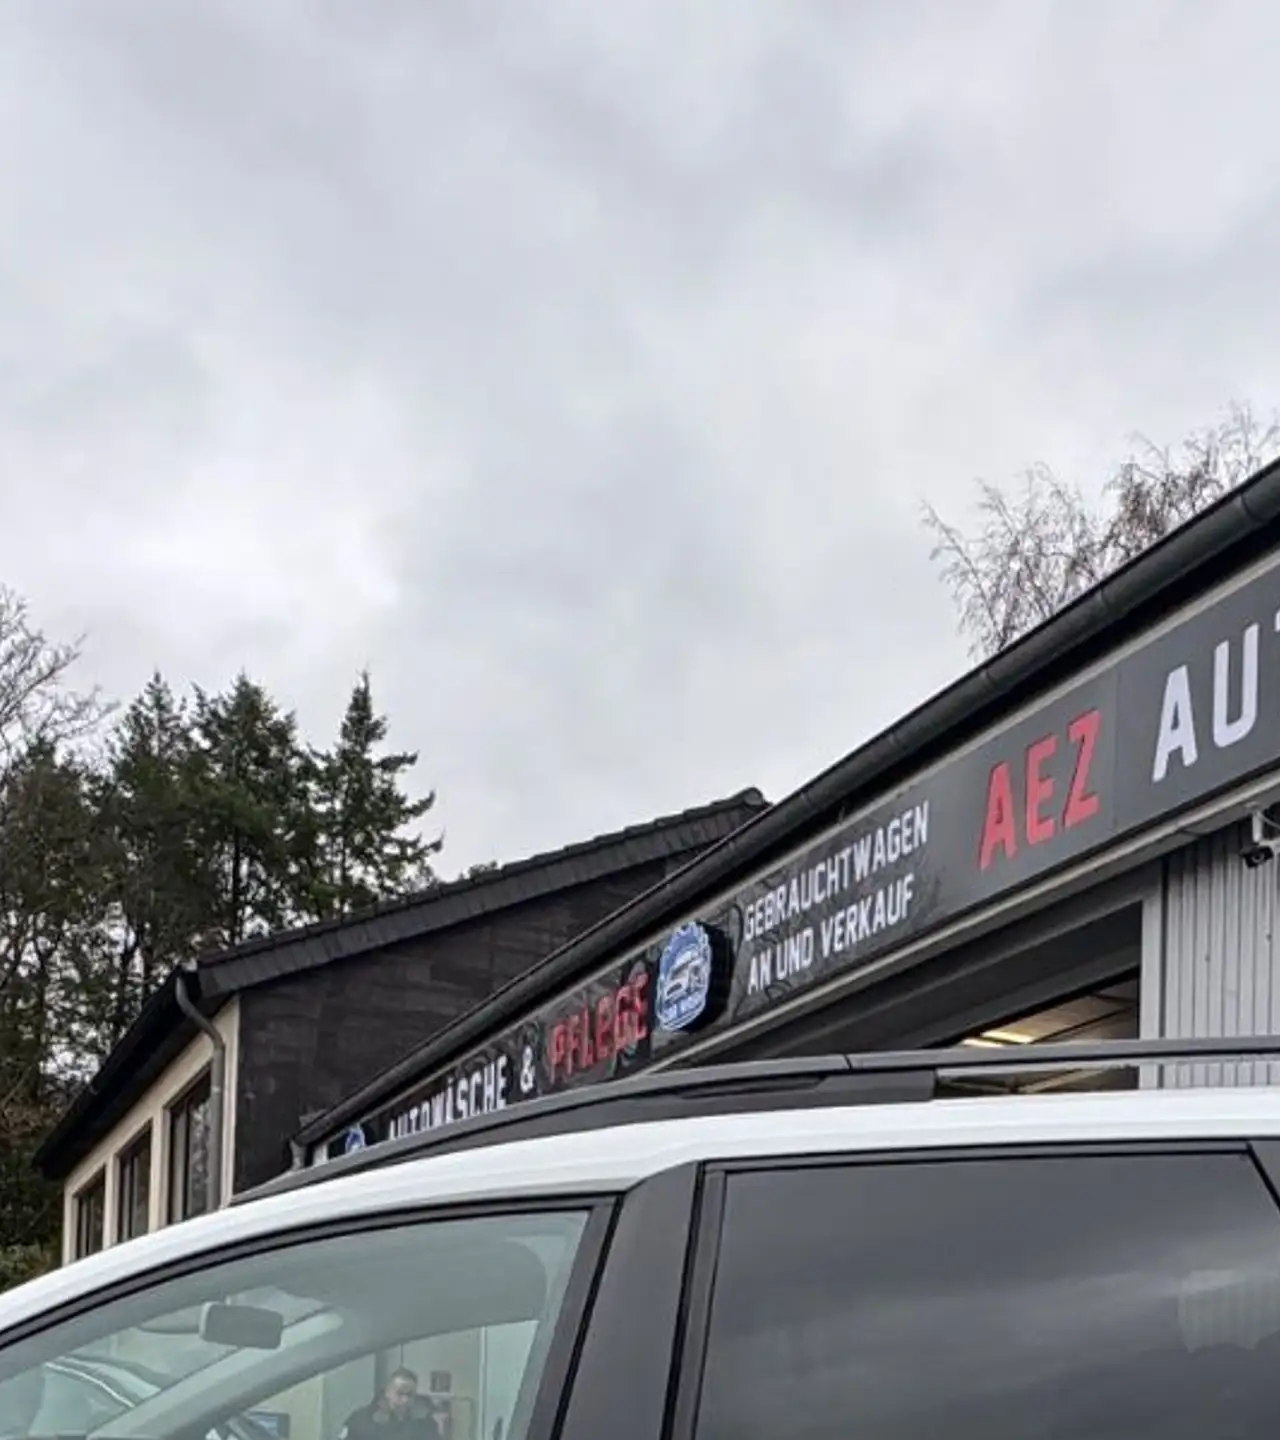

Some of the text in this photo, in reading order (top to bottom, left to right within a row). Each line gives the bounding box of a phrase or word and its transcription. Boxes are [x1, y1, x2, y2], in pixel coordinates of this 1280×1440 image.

[977, 708, 1102, 873] AEZ
[743, 799, 930, 943] GEBRAUCHTWAGEN
[747, 872, 915, 996] AN UND VERKAUF
[520, 1044, 537, 1094] &
